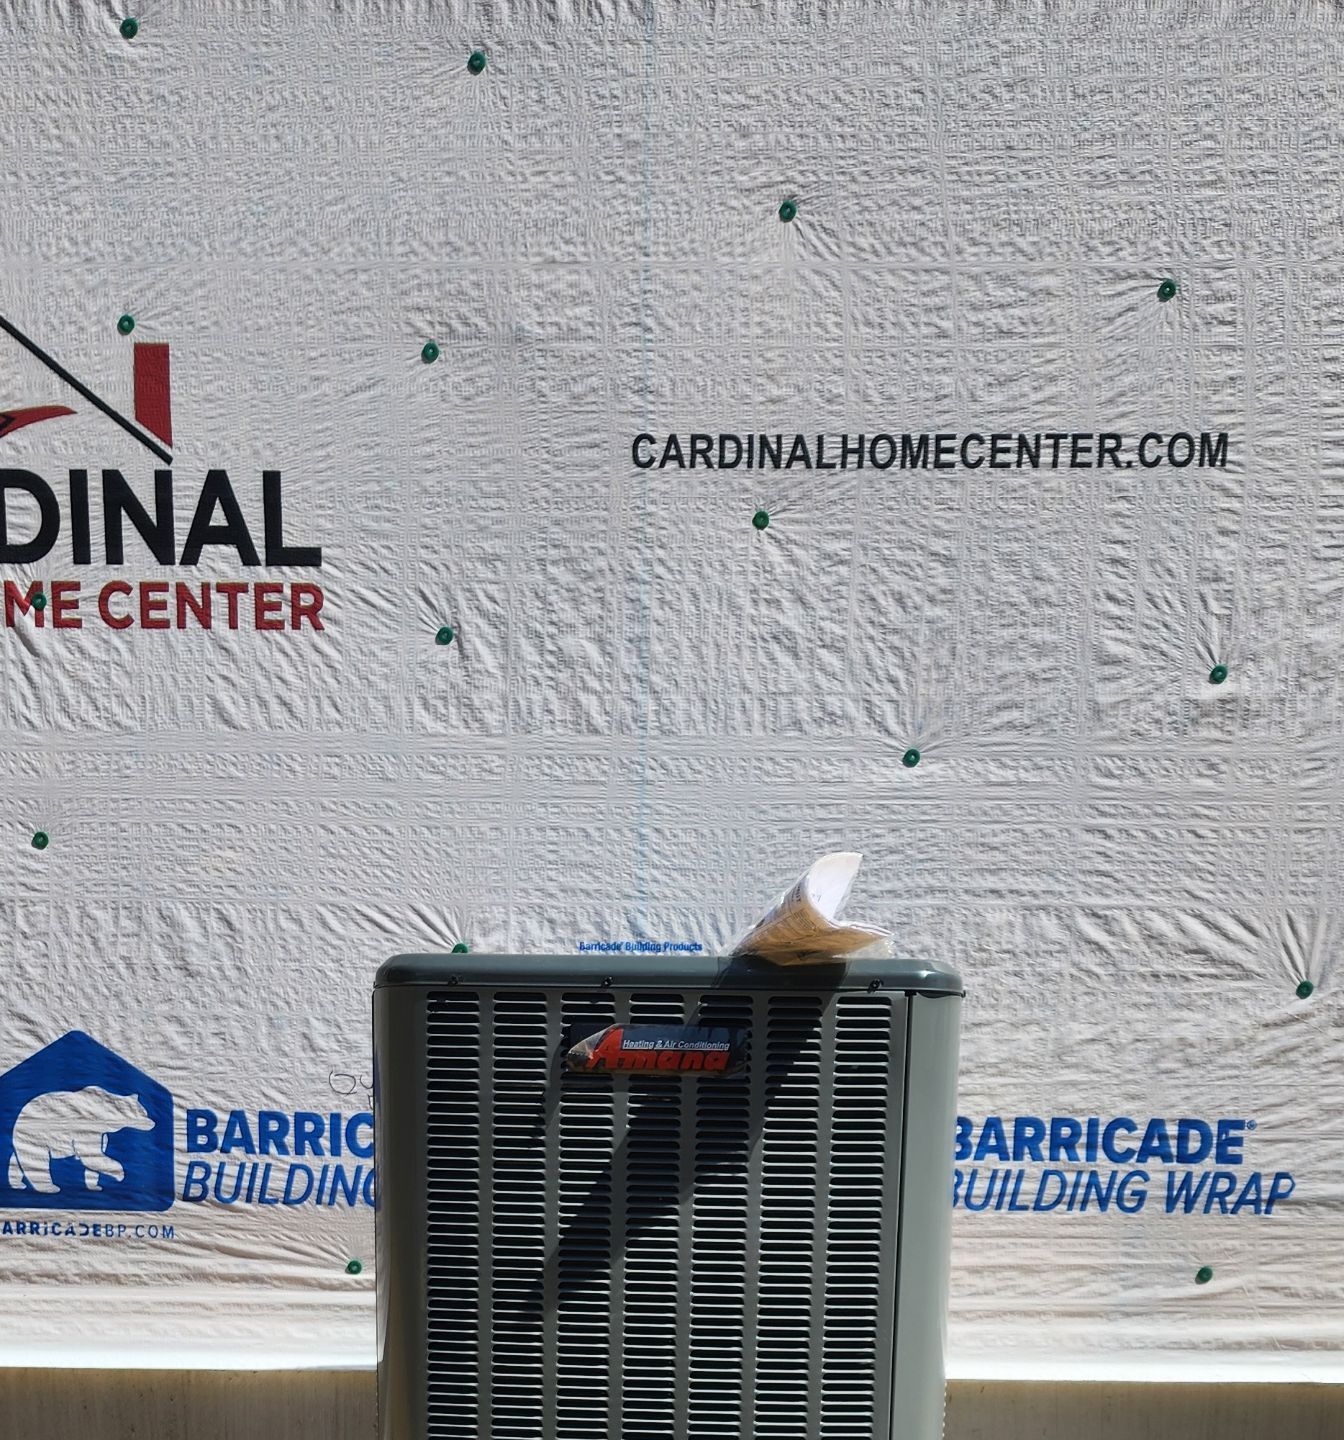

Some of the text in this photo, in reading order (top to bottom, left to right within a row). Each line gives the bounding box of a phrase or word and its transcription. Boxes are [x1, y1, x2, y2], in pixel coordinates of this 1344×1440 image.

[631, 432, 1231, 469] CARDINALHOMECENTER.COM
[0, 468, 322, 567] DINAL
[99, 581, 325, 630] CENTER
[625, 941, 661, 953] Building
[663, 941, 703, 952] Products
[588, 1028, 730, 1070] Amana
[623, 1039, 730, 1051] Heating & Air Conditioning
[1165, 1171, 1295, 1215] WRAP
